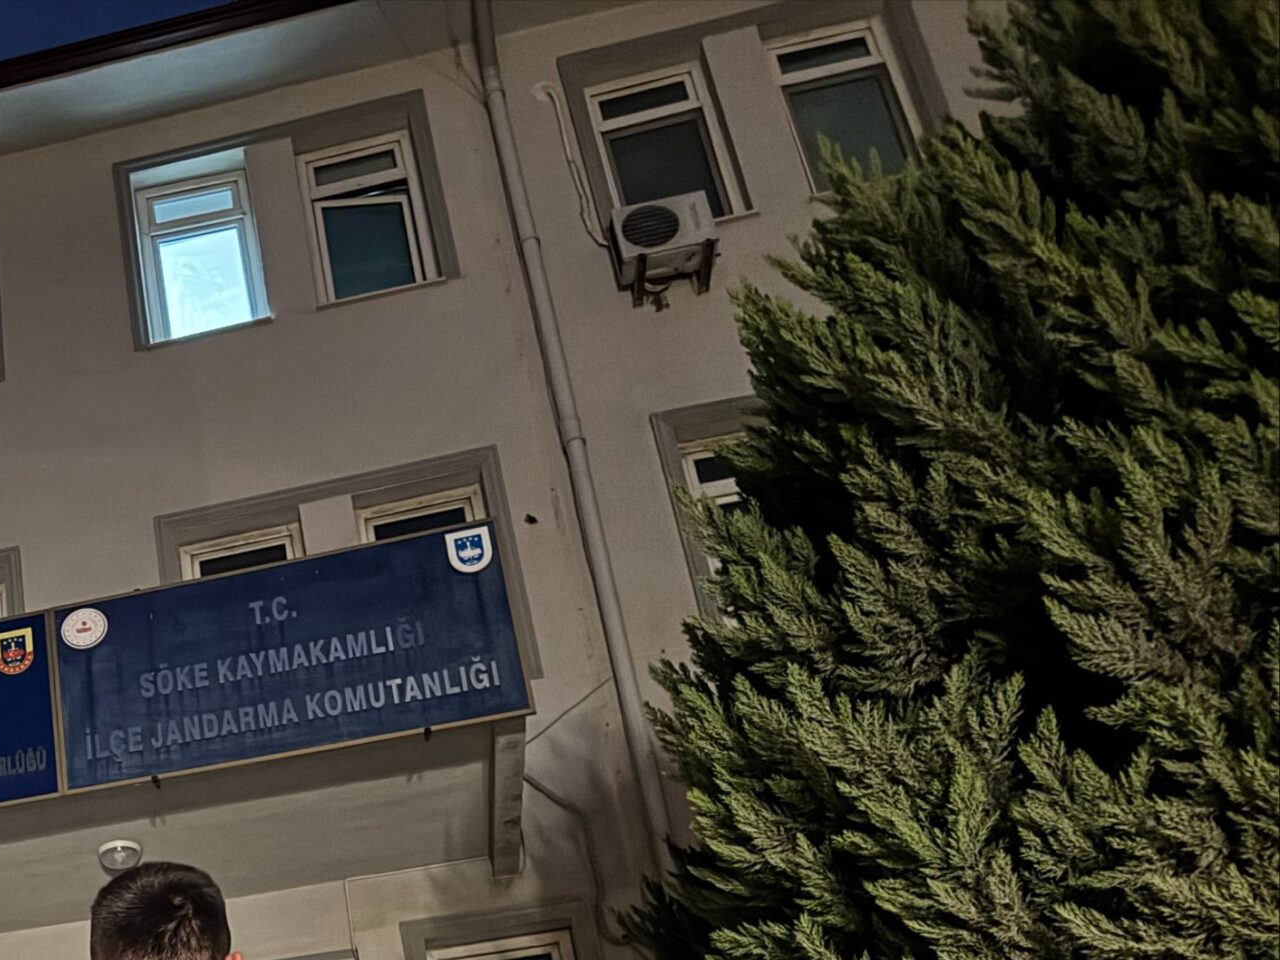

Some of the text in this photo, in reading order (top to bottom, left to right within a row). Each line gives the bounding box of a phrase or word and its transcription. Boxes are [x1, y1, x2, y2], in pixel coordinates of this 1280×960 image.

[249, 596, 297, 625] T.C.
[139, 616, 425, 698] SÖKE KAYMAKAMLIĞI
[86, 655, 501, 762] İLÇE JANDARMA KOMUTANLIĞI
